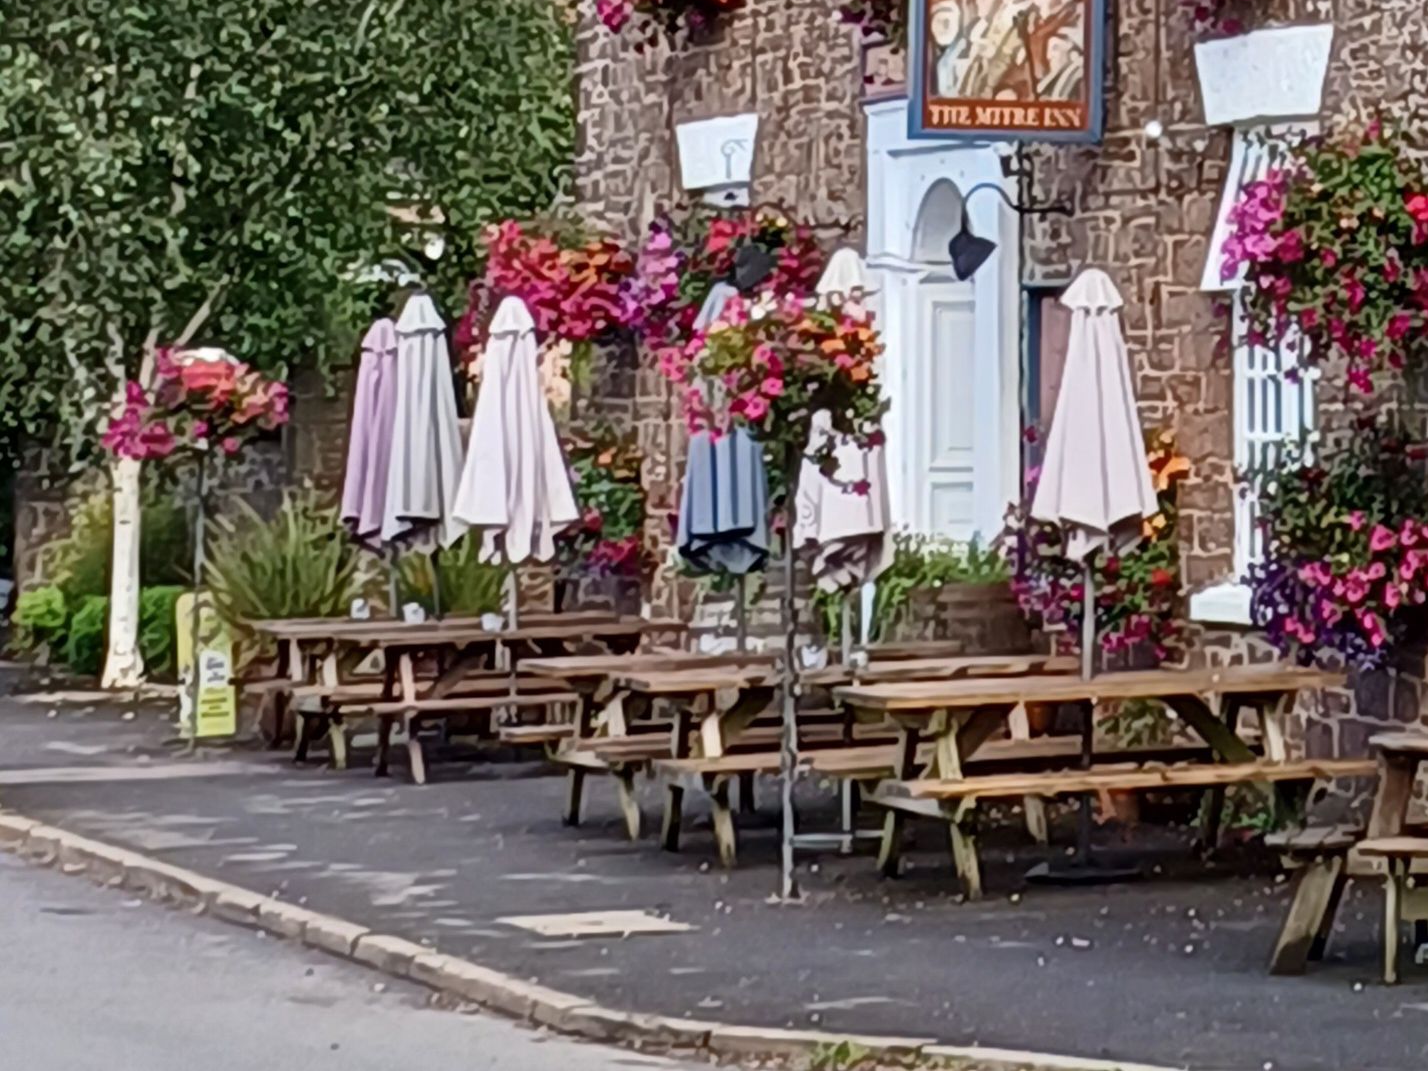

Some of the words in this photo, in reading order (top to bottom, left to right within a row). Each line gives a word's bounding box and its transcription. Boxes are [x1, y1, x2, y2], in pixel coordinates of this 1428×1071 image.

[929, 105, 971, 126] THE
[975, 106, 1040, 127] MITRE
[1044, 107, 1082, 127] INN
